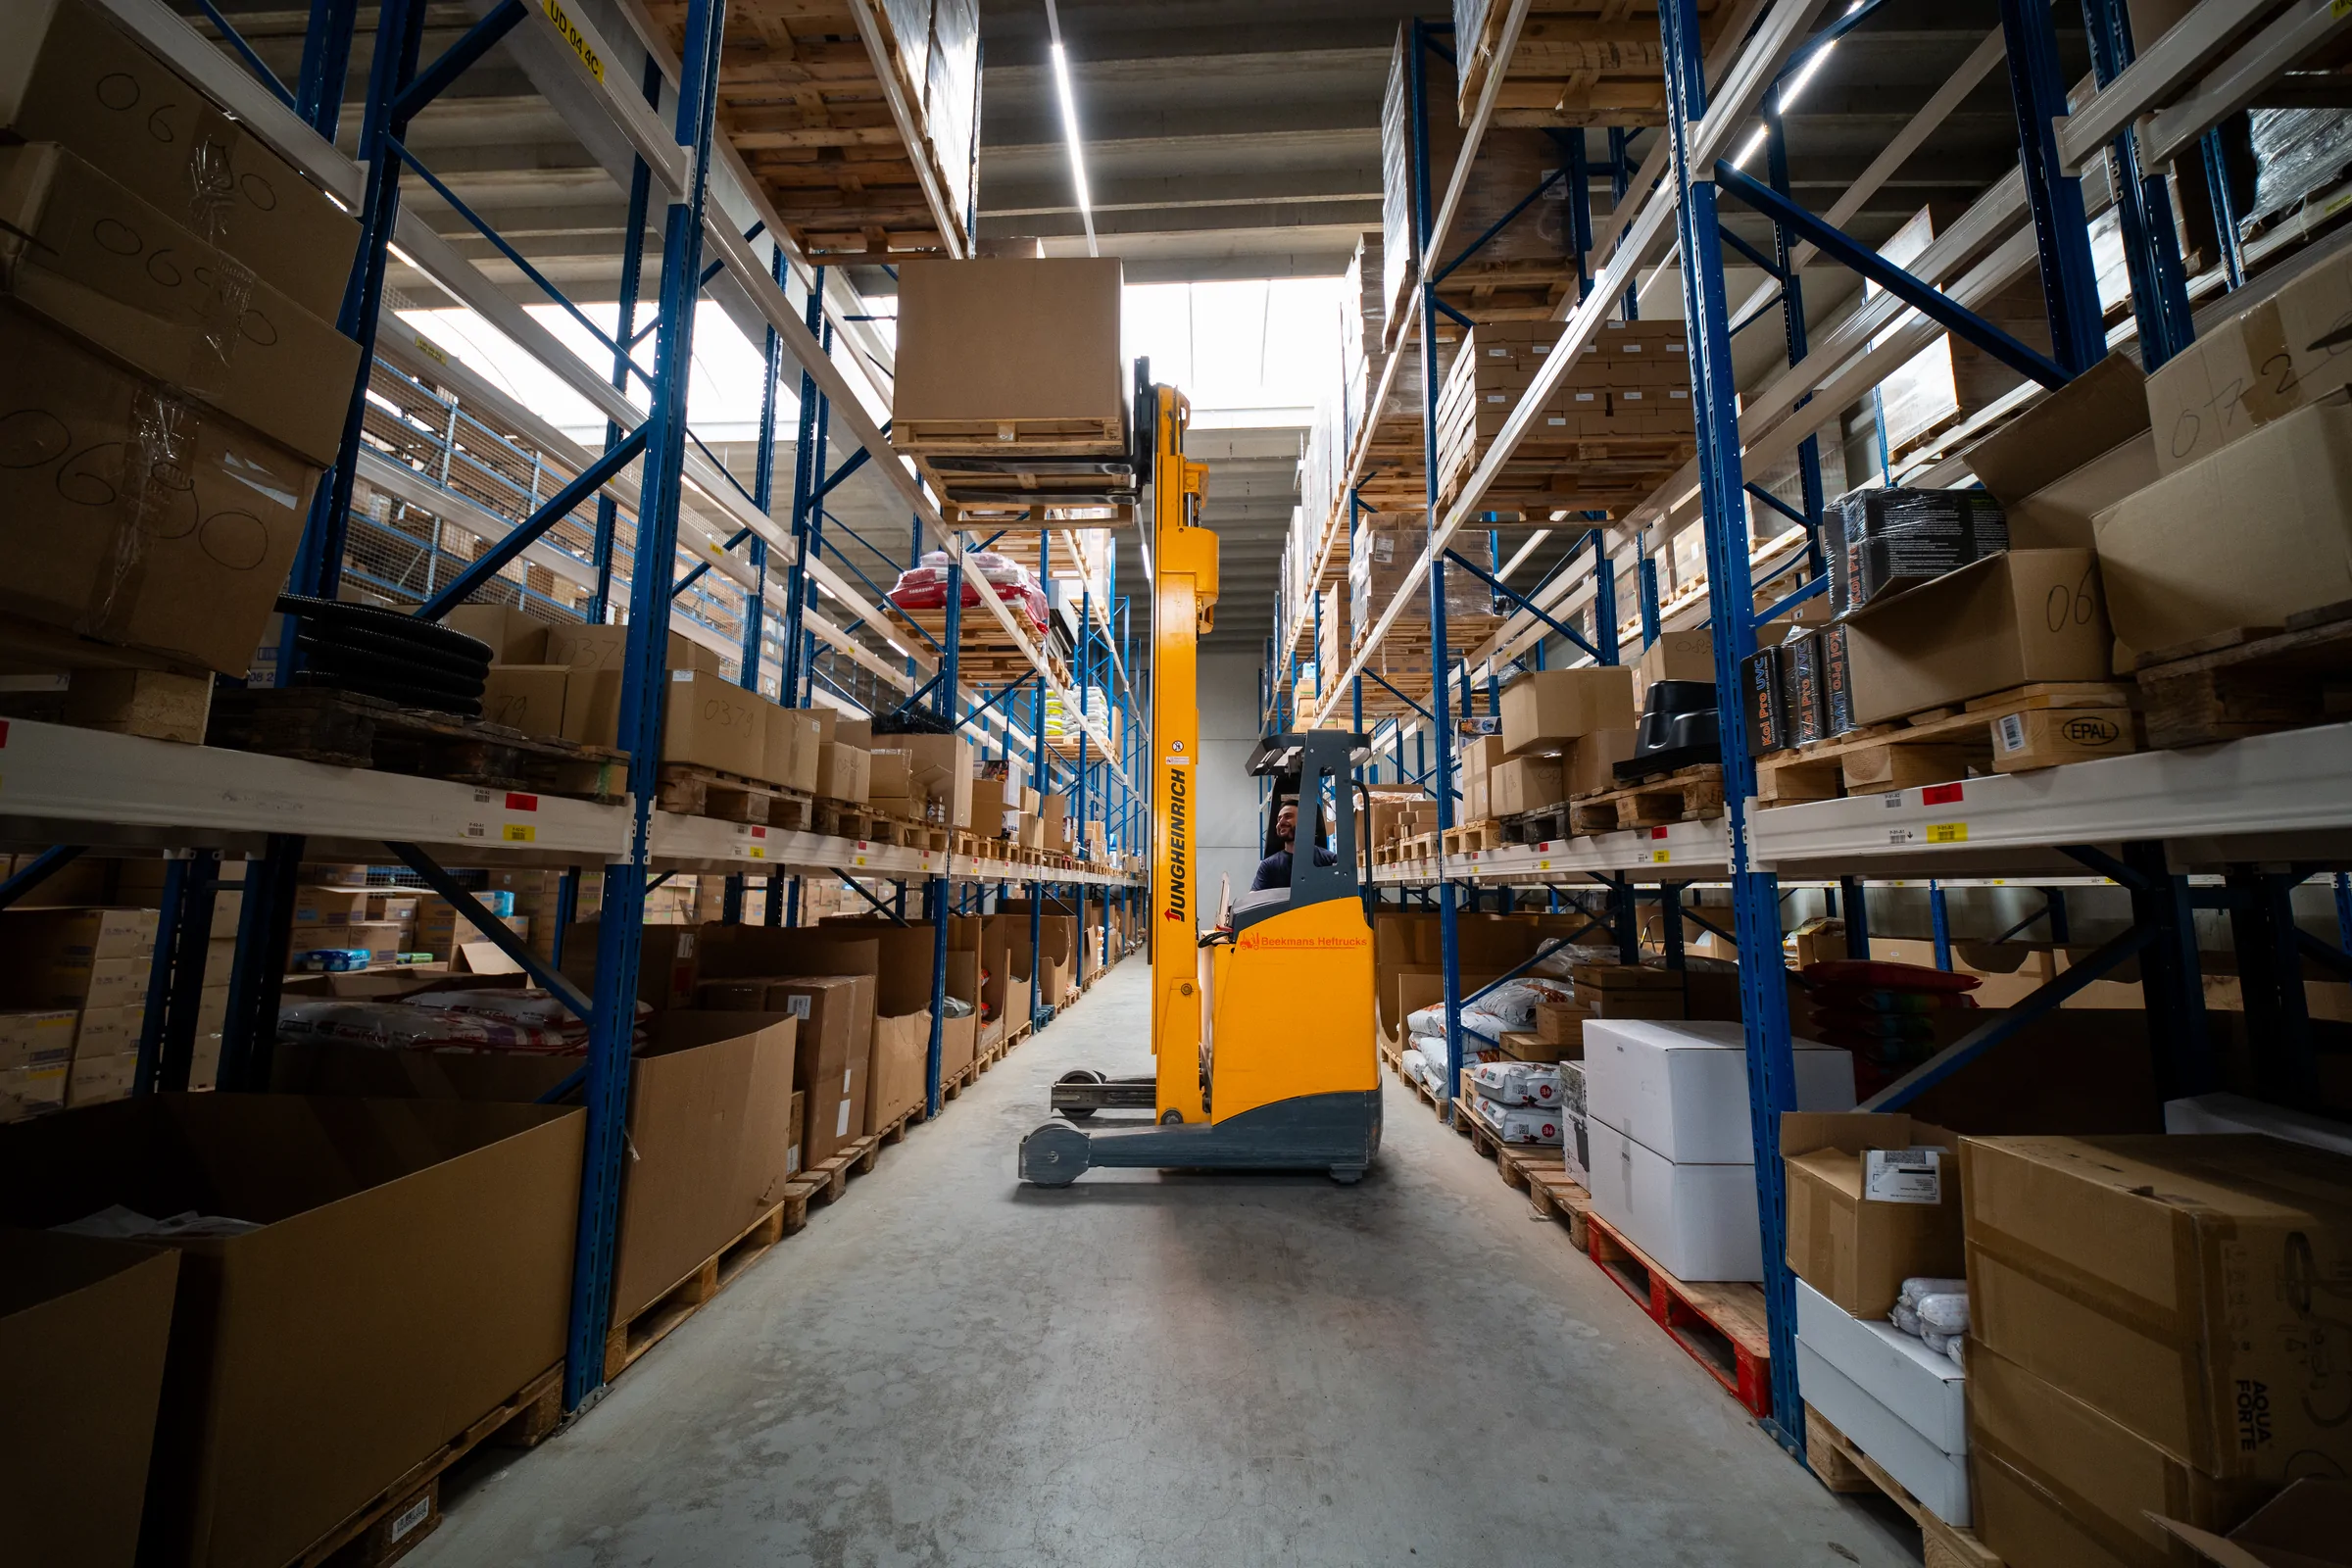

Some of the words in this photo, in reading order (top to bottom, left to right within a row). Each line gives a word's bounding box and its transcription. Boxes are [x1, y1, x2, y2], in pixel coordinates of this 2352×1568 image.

[550, 0, 567, 33] UD
[569, 26, 583, 55] 04
[584, 49, 599, 75] 4C
[1830, 631, 1842, 659] Koi
[1754, 657, 1765, 691] UVC
[1831, 662, 1842, 691] Pro
[1759, 692, 1769, 719] Pro
[1800, 678, 1812, 708] Pro
[1834, 694, 1847, 731] UVC
[1762, 720, 1772, 747] Koi
[2070, 721, 2112, 740] EPAL
[1170, 768, 1186, 922] JUNGHEINRICH
[1261, 937, 1314, 946] Beekmans
[1318, 937, 1367, 946] Heftrucks
[2234, 1380, 2256, 1451] FORTE
[2252, 1380, 2272, 1444] AQUA
